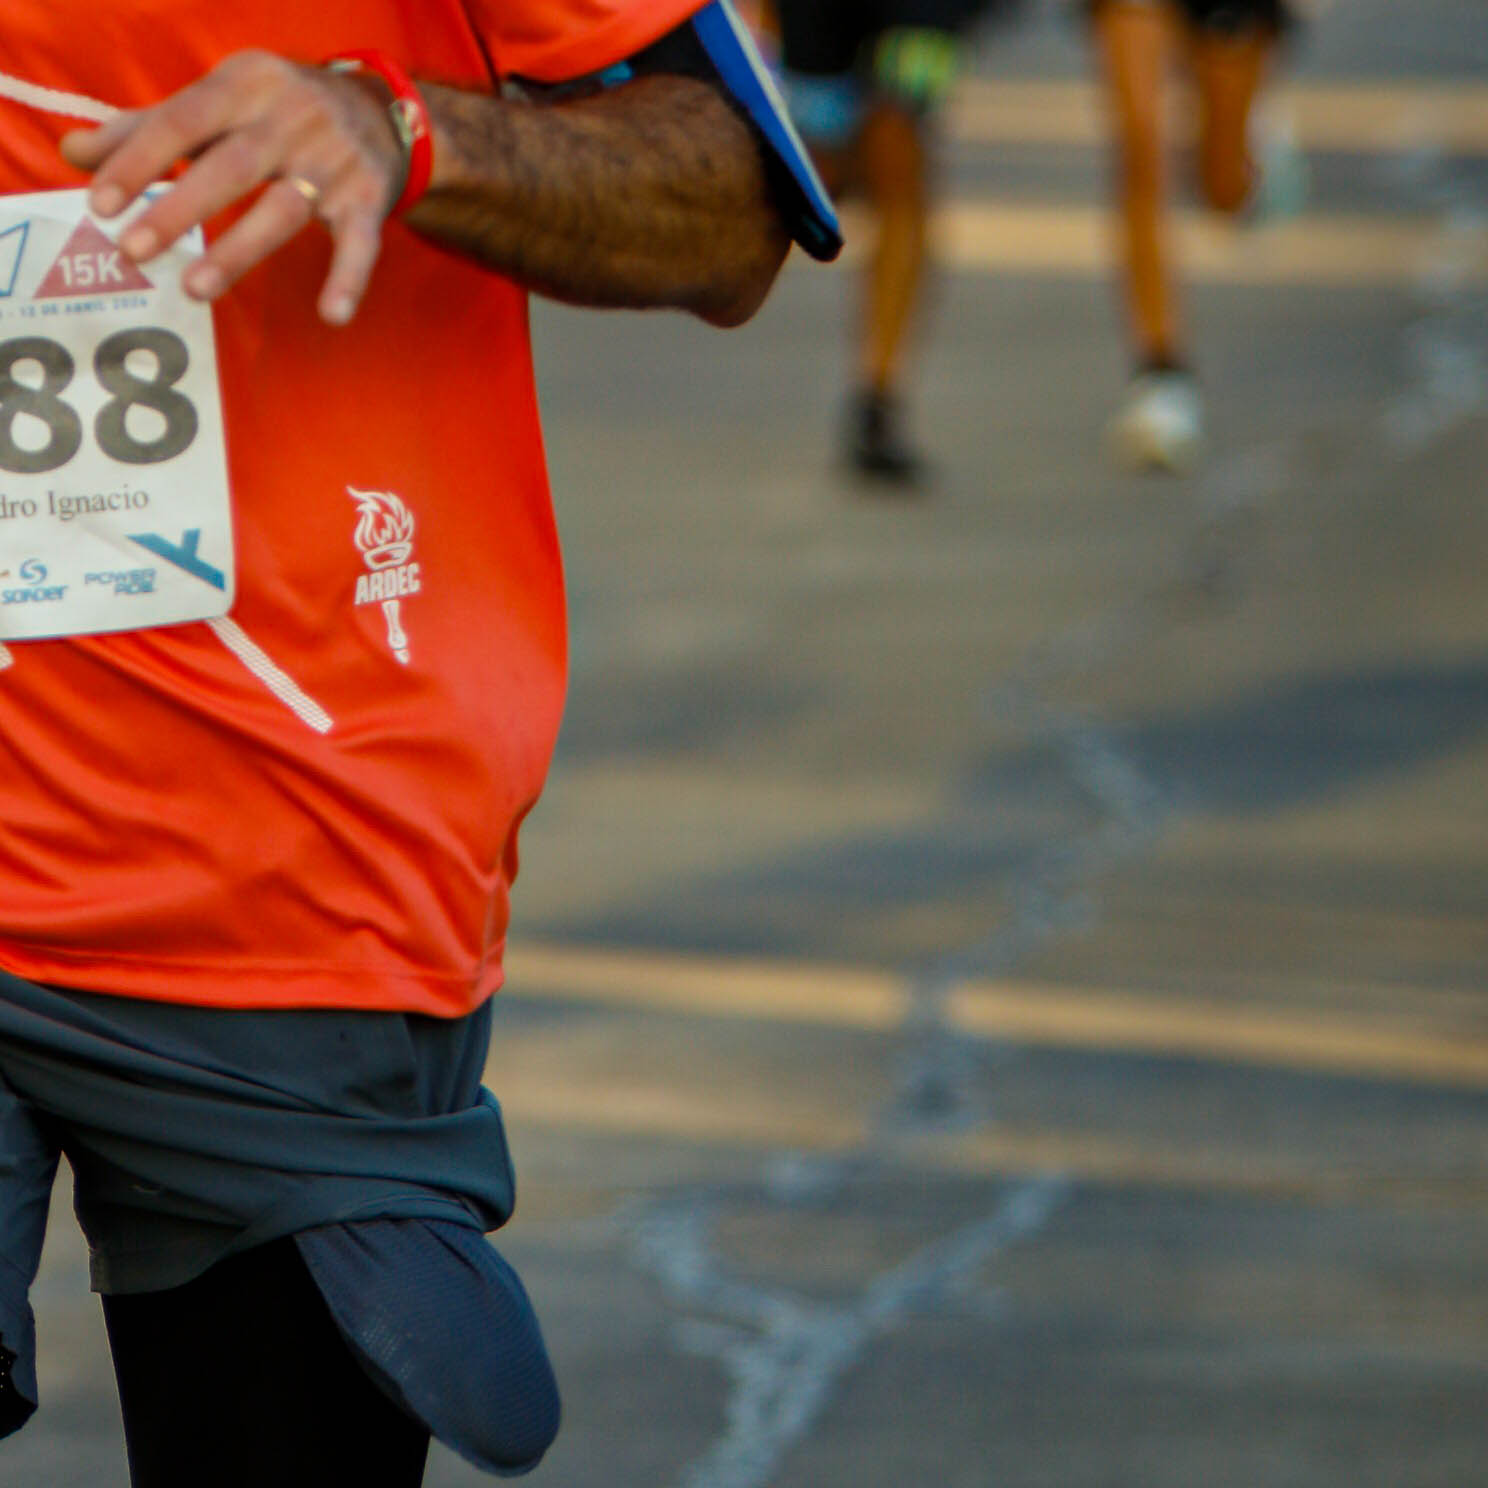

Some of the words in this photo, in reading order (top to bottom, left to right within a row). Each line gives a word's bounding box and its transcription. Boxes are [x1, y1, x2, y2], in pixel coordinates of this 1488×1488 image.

[57, 250, 124, 287] 15K
[48, 483, 150, 519] Ignacio
[354, 562, 422, 606] ARDEC
